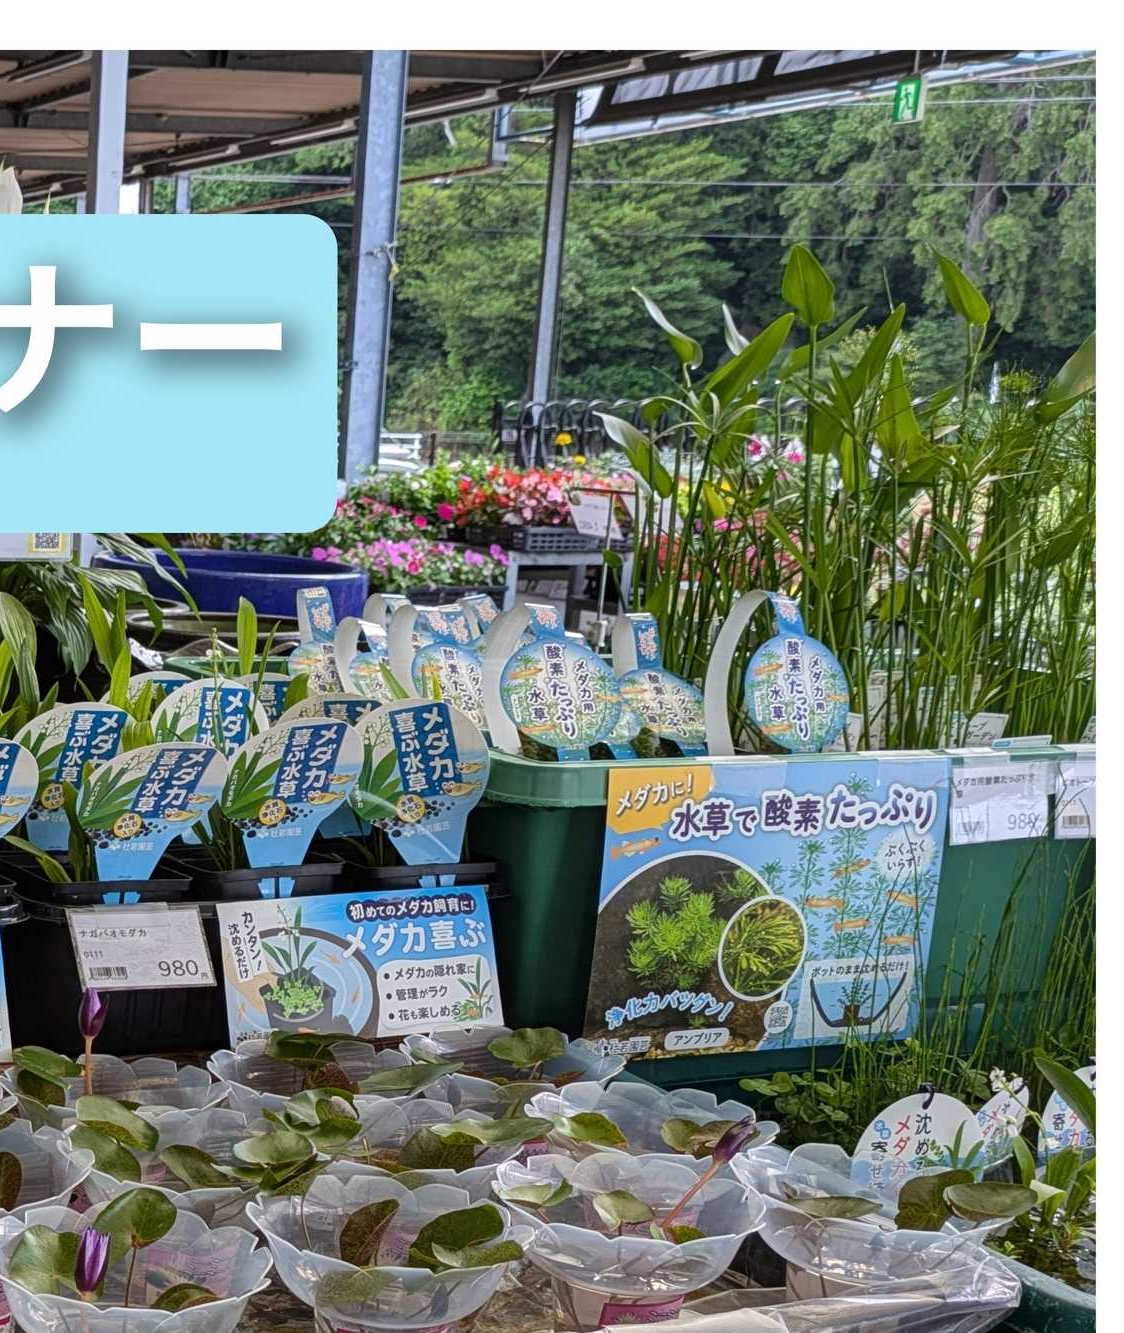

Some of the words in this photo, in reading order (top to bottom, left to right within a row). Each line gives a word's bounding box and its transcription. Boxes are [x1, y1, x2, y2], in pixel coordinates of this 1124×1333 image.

[528, 688, 548, 721] 水草
[545, 645, 578, 738] 酸素たっぷり
[575, 659, 595, 713] メダカ用
[771, 688, 785, 720] 水草
[787, 641, 809, 739] 酸素たっぷり
[810, 657, 825, 713] メダカ用
[278, 728, 313, 799] 喜ぶ水草
[305, 724, 338, 791] メダカ
[392, 714, 428, 793] 喜ぶ水草
[424, 708, 456, 779] メダカ
[138, 749, 179, 814] 喜ぶ水草
[165, 749, 205, 810] メダカ
[615, 775, 693, 816] メダカに!
[79, 927, 147, 940] ナガバオモダカ
[349, 899, 475, 921] 初めてのメダカ飼育に!
[228, 923, 250, 979] 沈めるだけ
[242, 910, 263, 972] カンタン!
[344, 919, 485, 959] メダカ喜ぶ
[394, 963, 475, 980] メダカの隠れ家に
[396, 985, 447, 1000] 管理がラク
[398, 1003, 461, 1020] 花も楽しめる
[607, 994, 731, 1030] 浄化力バツグン!
[674, 1031, 723, 1046] アンブリア
